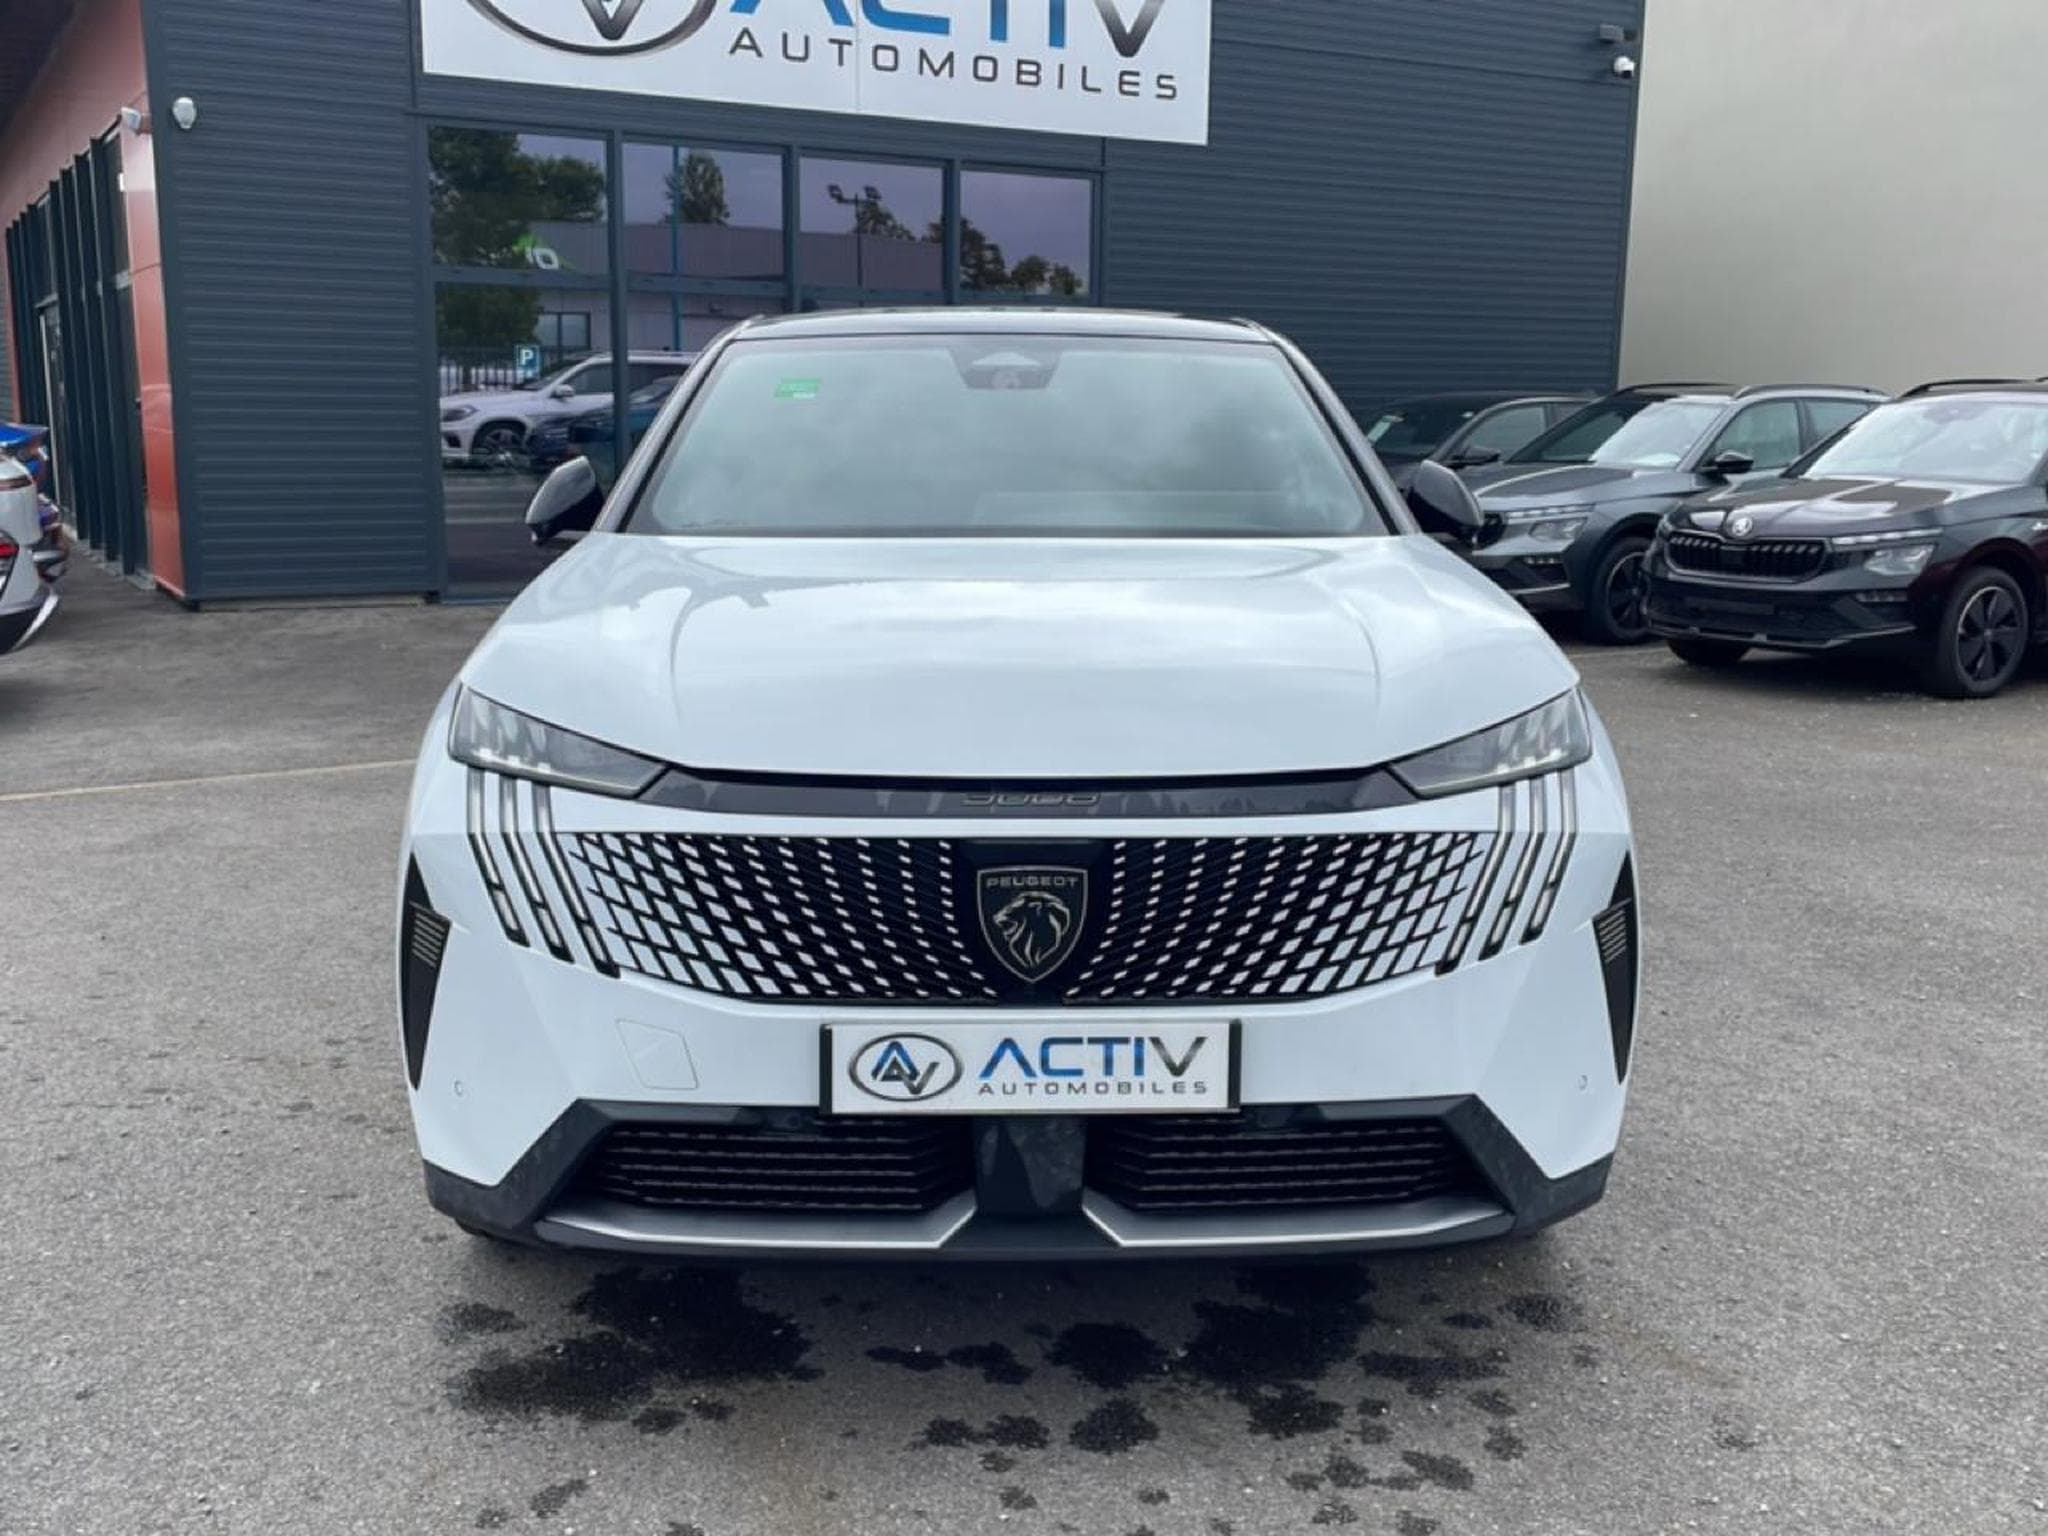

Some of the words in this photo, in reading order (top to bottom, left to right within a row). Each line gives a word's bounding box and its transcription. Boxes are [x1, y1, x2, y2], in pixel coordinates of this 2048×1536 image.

[728, 27, 1177, 100] AUTOMOBILES
[986, 875, 1078, 888] PEUGEOT
[979, 1036, 1208, 1078] ACTIV
[978, 1081, 1208, 1096] AUTOMOBILES
